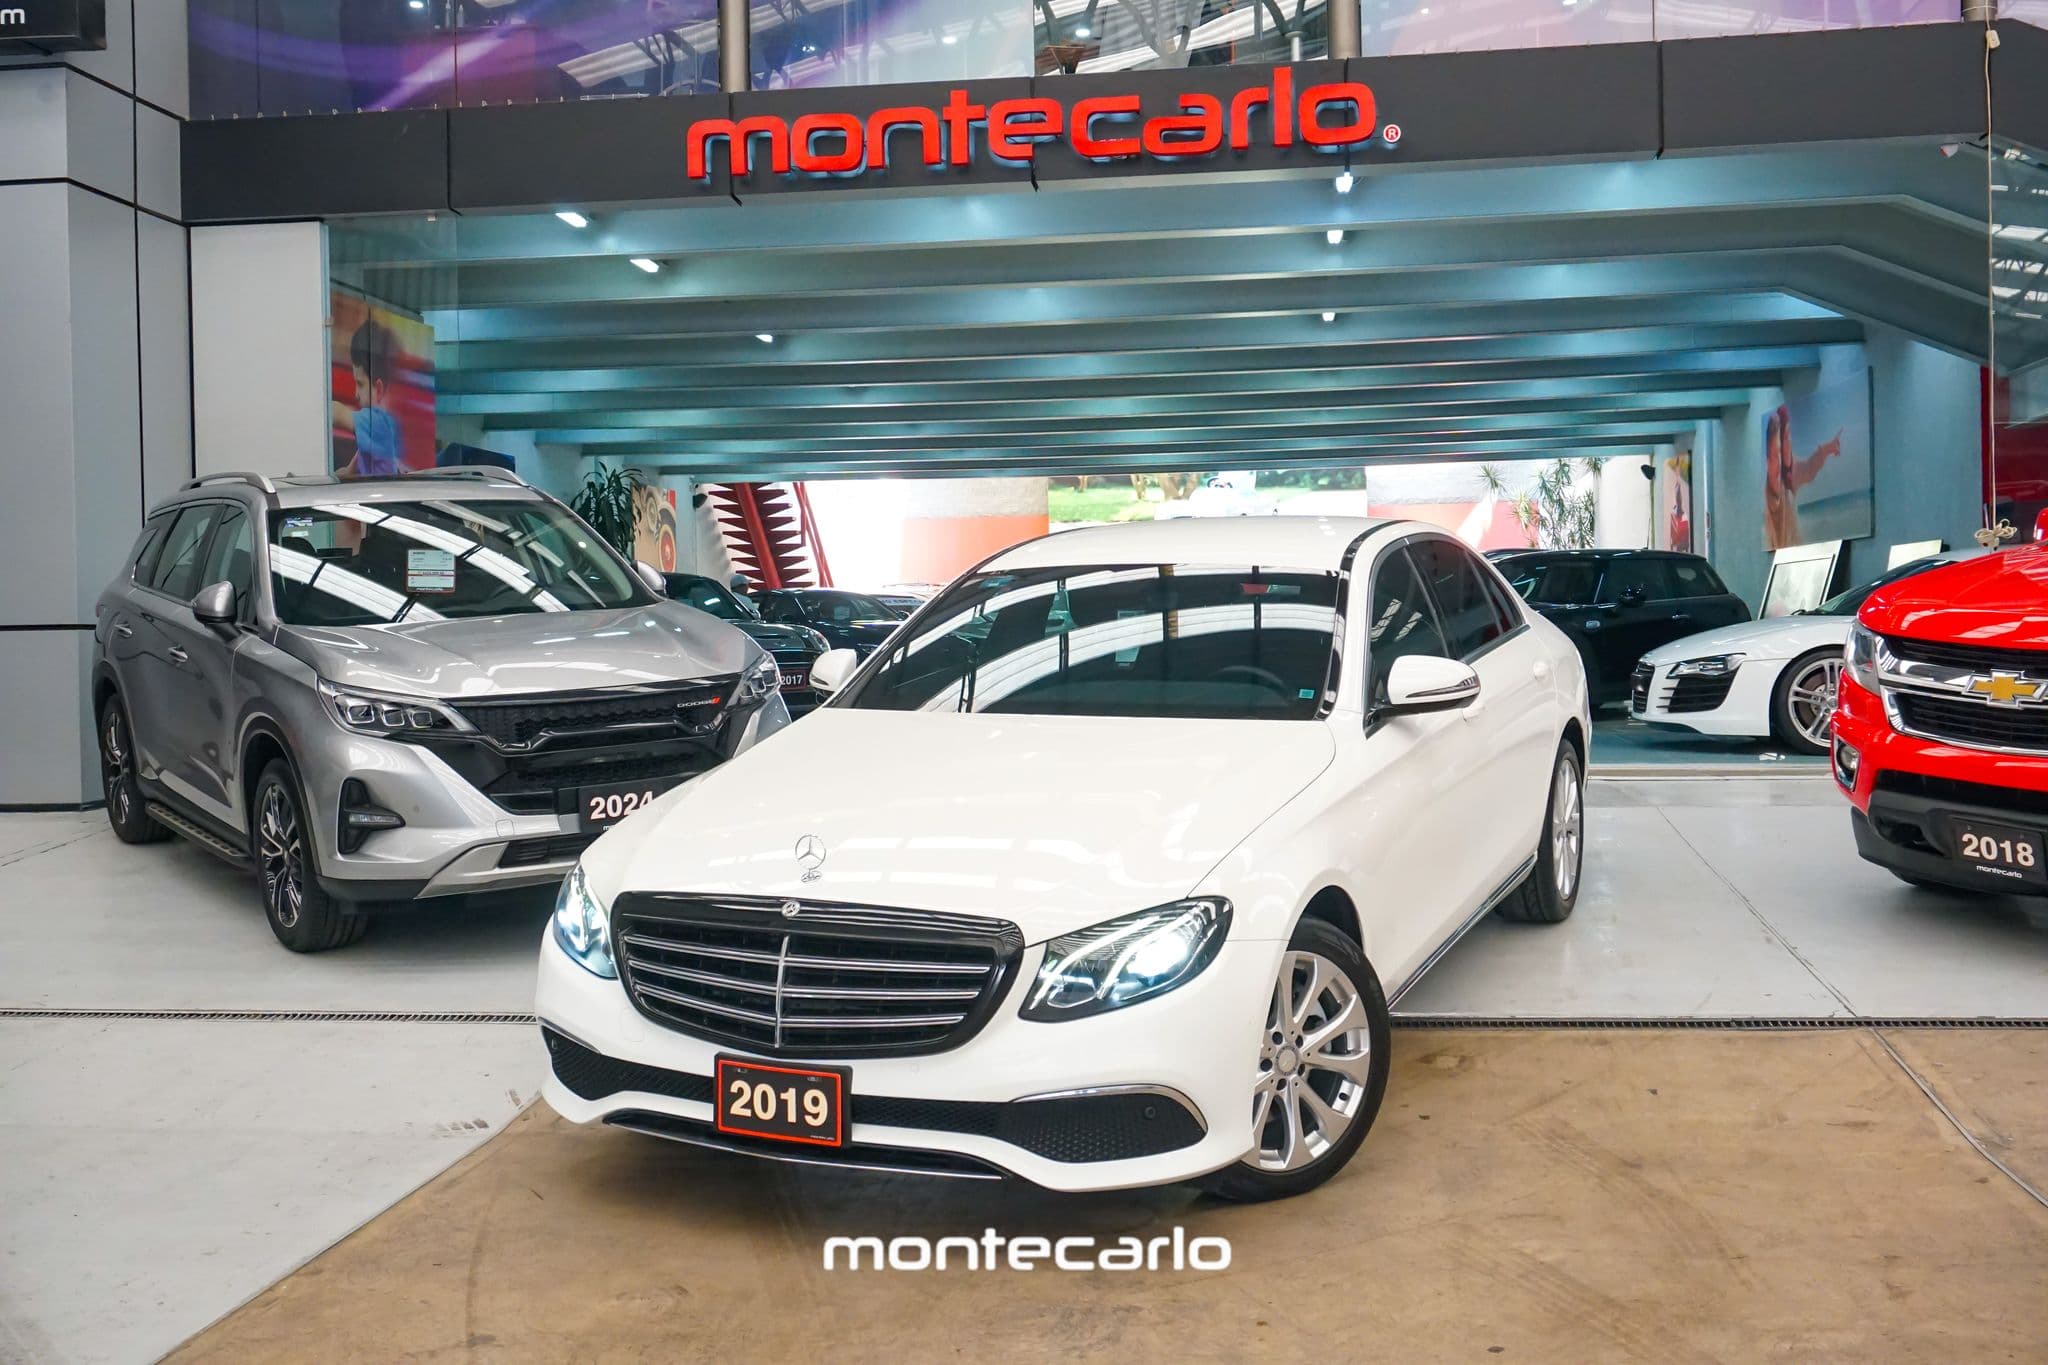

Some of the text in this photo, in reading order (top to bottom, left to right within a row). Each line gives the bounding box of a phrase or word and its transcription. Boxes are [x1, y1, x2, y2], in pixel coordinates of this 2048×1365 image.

[687, 66, 1376, 179] montecarlo
[1961, 833, 2035, 867] 2018
[1976, 865, 2022, 878] montecarlo
[730, 1080, 828, 1127] 2019
